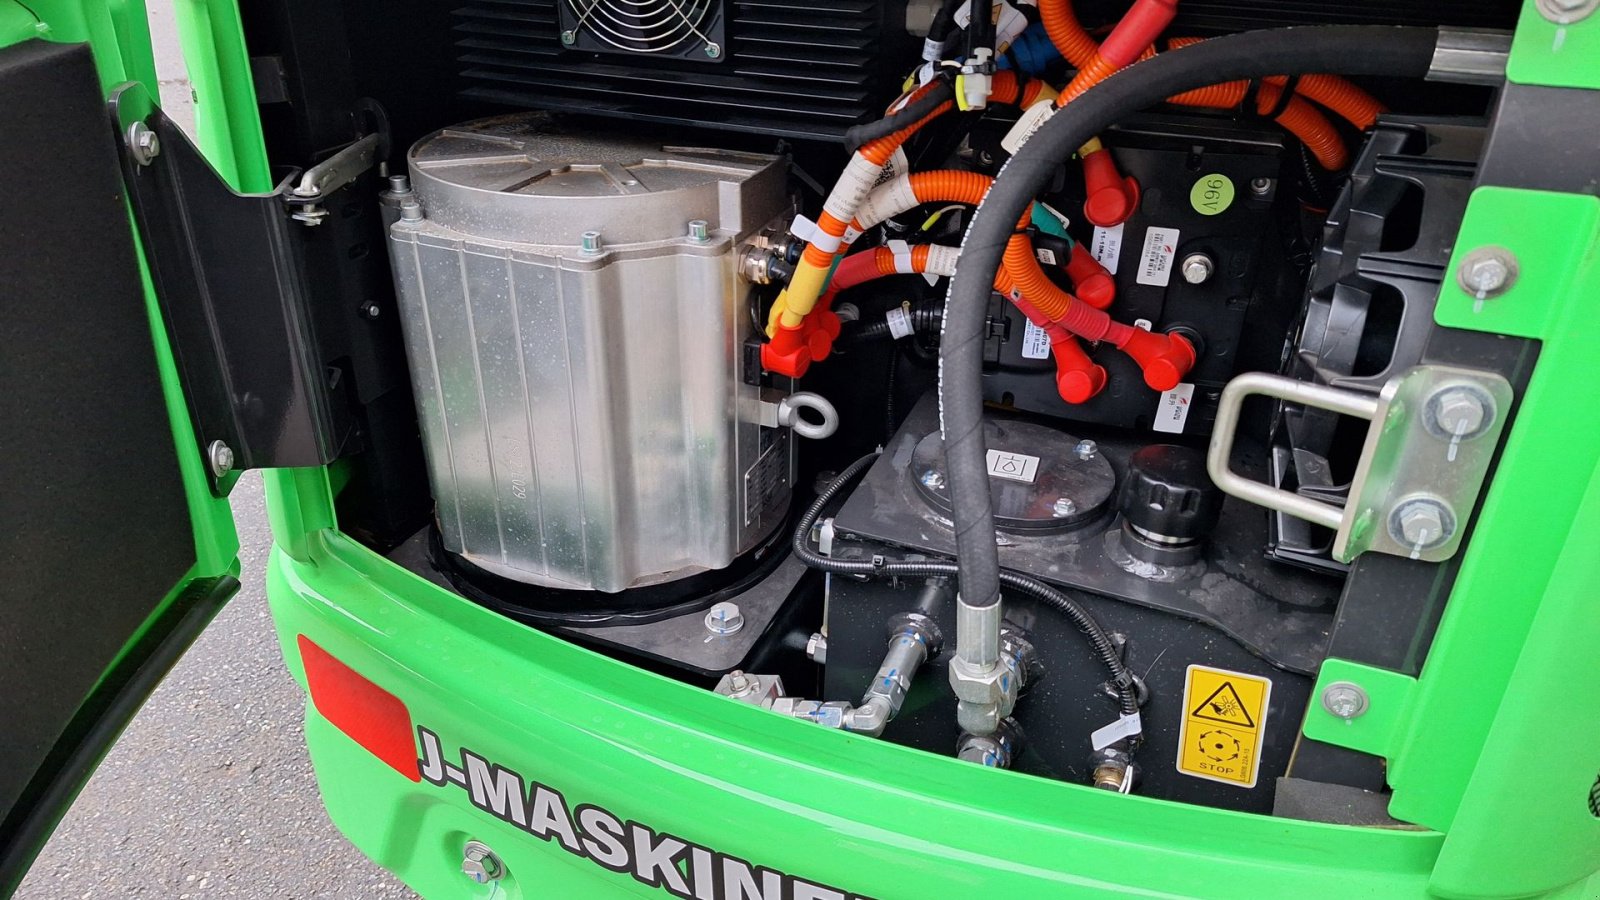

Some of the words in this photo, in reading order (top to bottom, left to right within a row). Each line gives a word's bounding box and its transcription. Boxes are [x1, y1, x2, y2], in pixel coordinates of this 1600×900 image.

[1202, 180, 1224, 211] 96V
[1199, 761, 1234, 774] STOP
[417, 729, 868, 900] J-MASKIN
